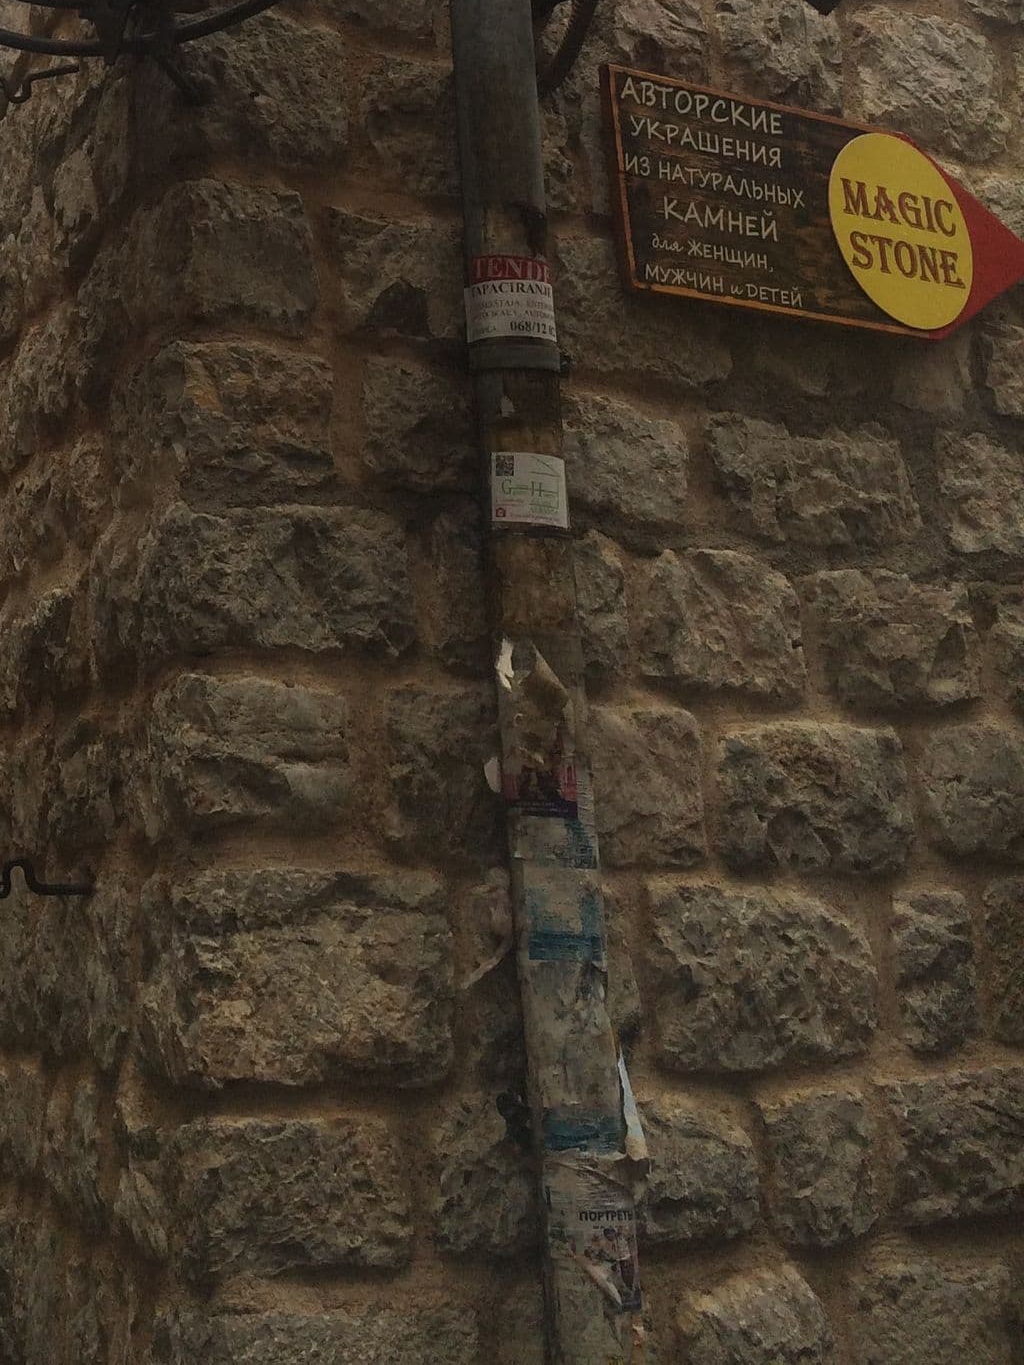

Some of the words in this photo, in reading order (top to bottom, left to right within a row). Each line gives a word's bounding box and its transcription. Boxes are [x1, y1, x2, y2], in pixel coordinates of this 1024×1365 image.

[620, 77, 783, 135] АВТОРСКИЕ
[629, 114, 782, 168] УКРАШЕНИЯ
[624, 152, 650, 177] ИЗ
[658, 161, 805, 209] НАТУРАЛЬНЫХ
[839, 177, 957, 237] MAGIC
[661, 195, 778, 242] КАМНЕЙ
[644, 263, 724, 293] МУЖЧИН
[651, 234, 684, 254] для
[686, 239, 774, 273] ЖЕНЩИН,
[849, 230, 966, 290] STONE
